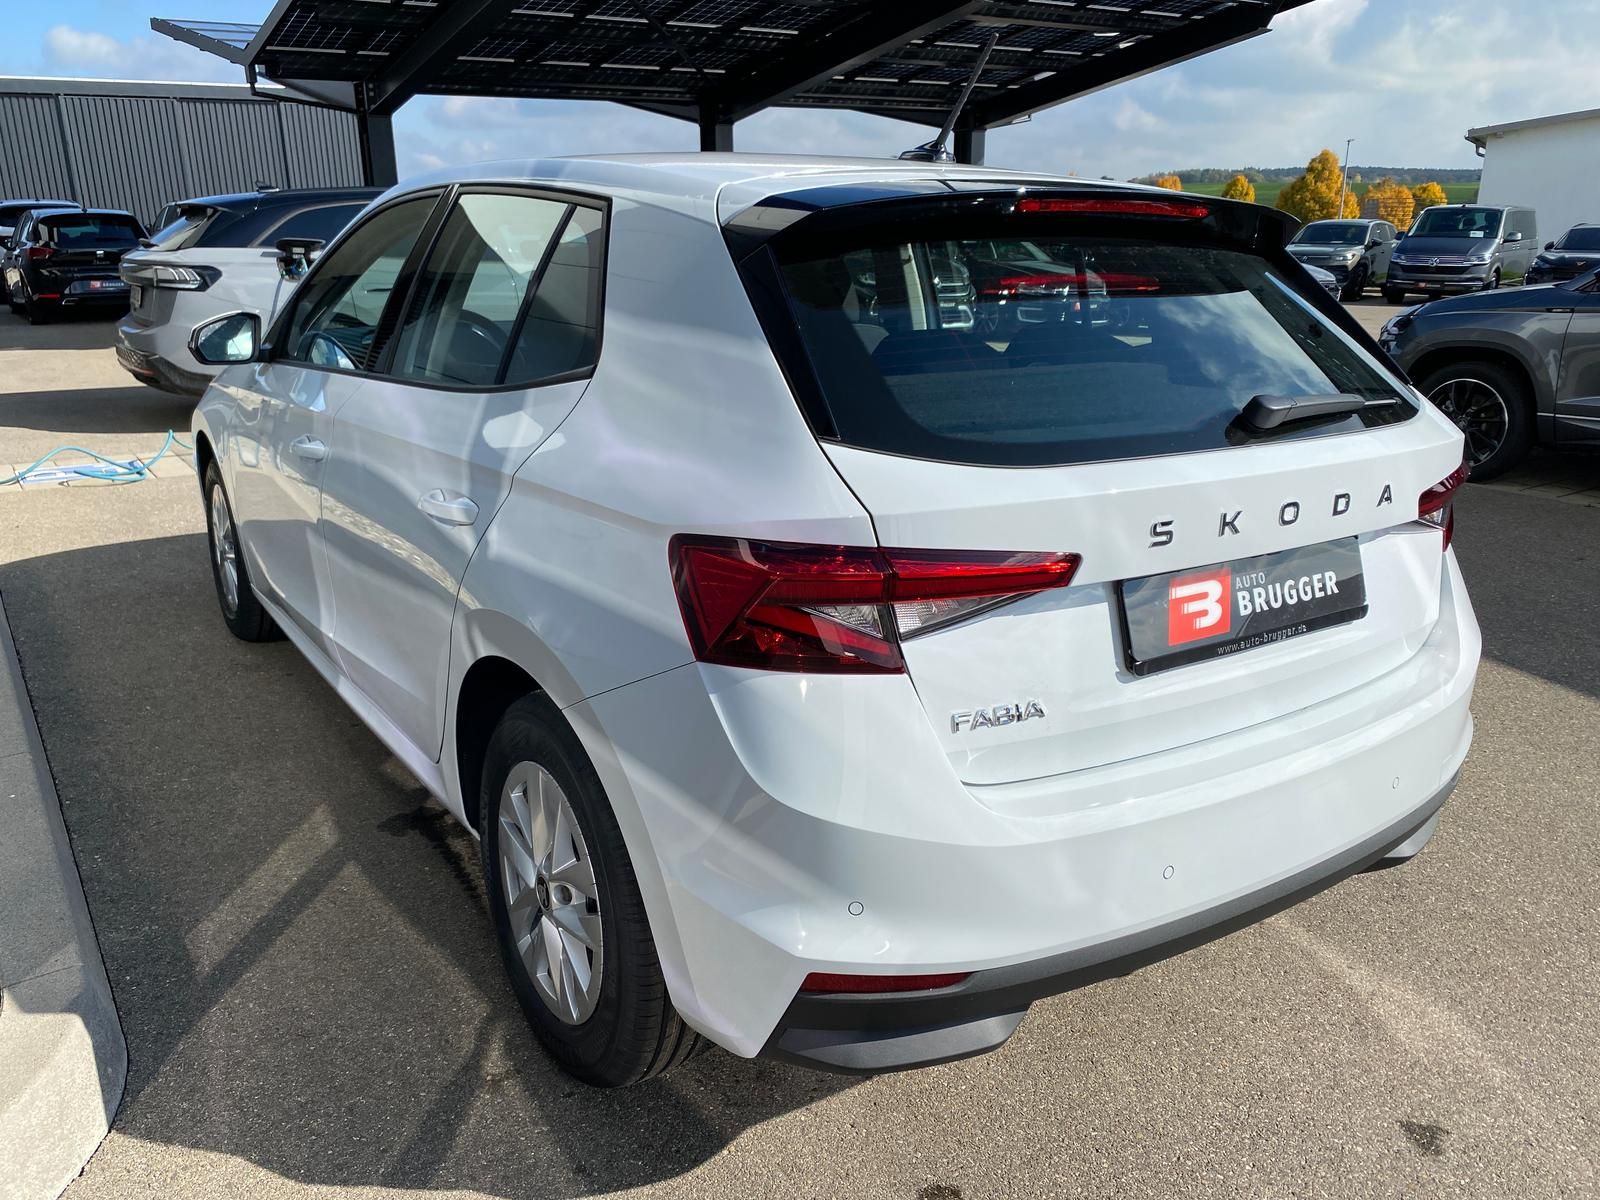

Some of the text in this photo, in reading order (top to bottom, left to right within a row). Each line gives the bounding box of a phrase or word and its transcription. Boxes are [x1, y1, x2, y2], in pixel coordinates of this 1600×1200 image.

[1148, 484, 1393, 548] SKODA
[1235, 572, 1266, 590] AUTO
[1237, 571, 1340, 616] BRUGGER
[951, 699, 1045, 734] FABIA
